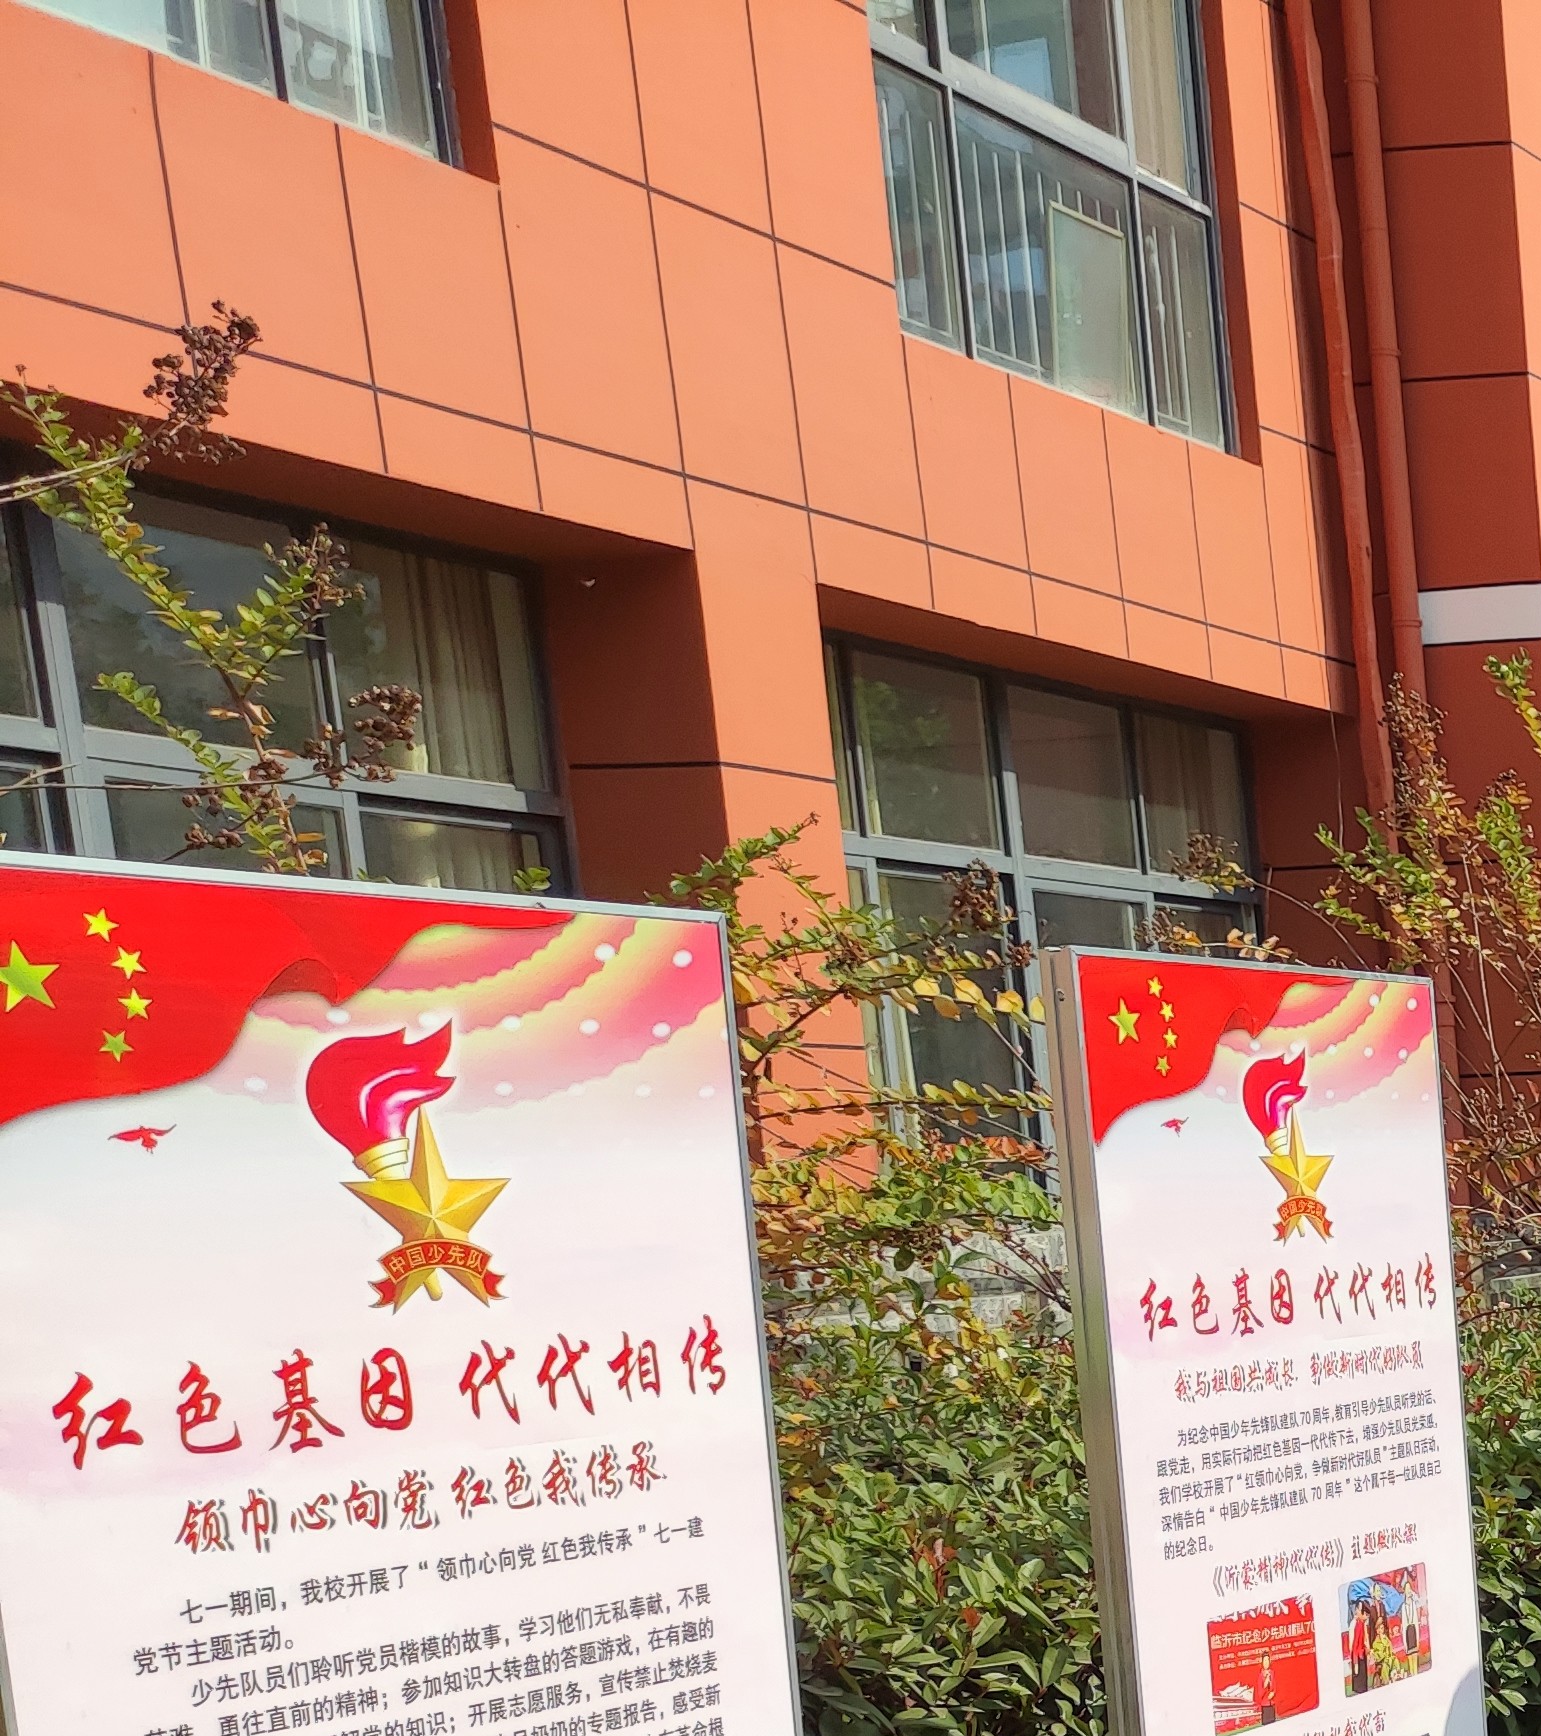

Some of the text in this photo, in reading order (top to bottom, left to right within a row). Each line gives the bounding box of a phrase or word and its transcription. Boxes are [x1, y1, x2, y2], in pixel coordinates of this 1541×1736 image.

[388, 1243, 485, 1274] 中国少先队
[1140, 1252, 1436, 1342] 红色基因 代代相传
[52, 1315, 727, 1470] 红色基因 代代相传
[174, 1441, 668, 1554] 领巾心向党 红色我传承
[1163, 1535, 1214, 1561] 的纪念日。
[133, 1625, 295, 1677] 党节主题活动。
